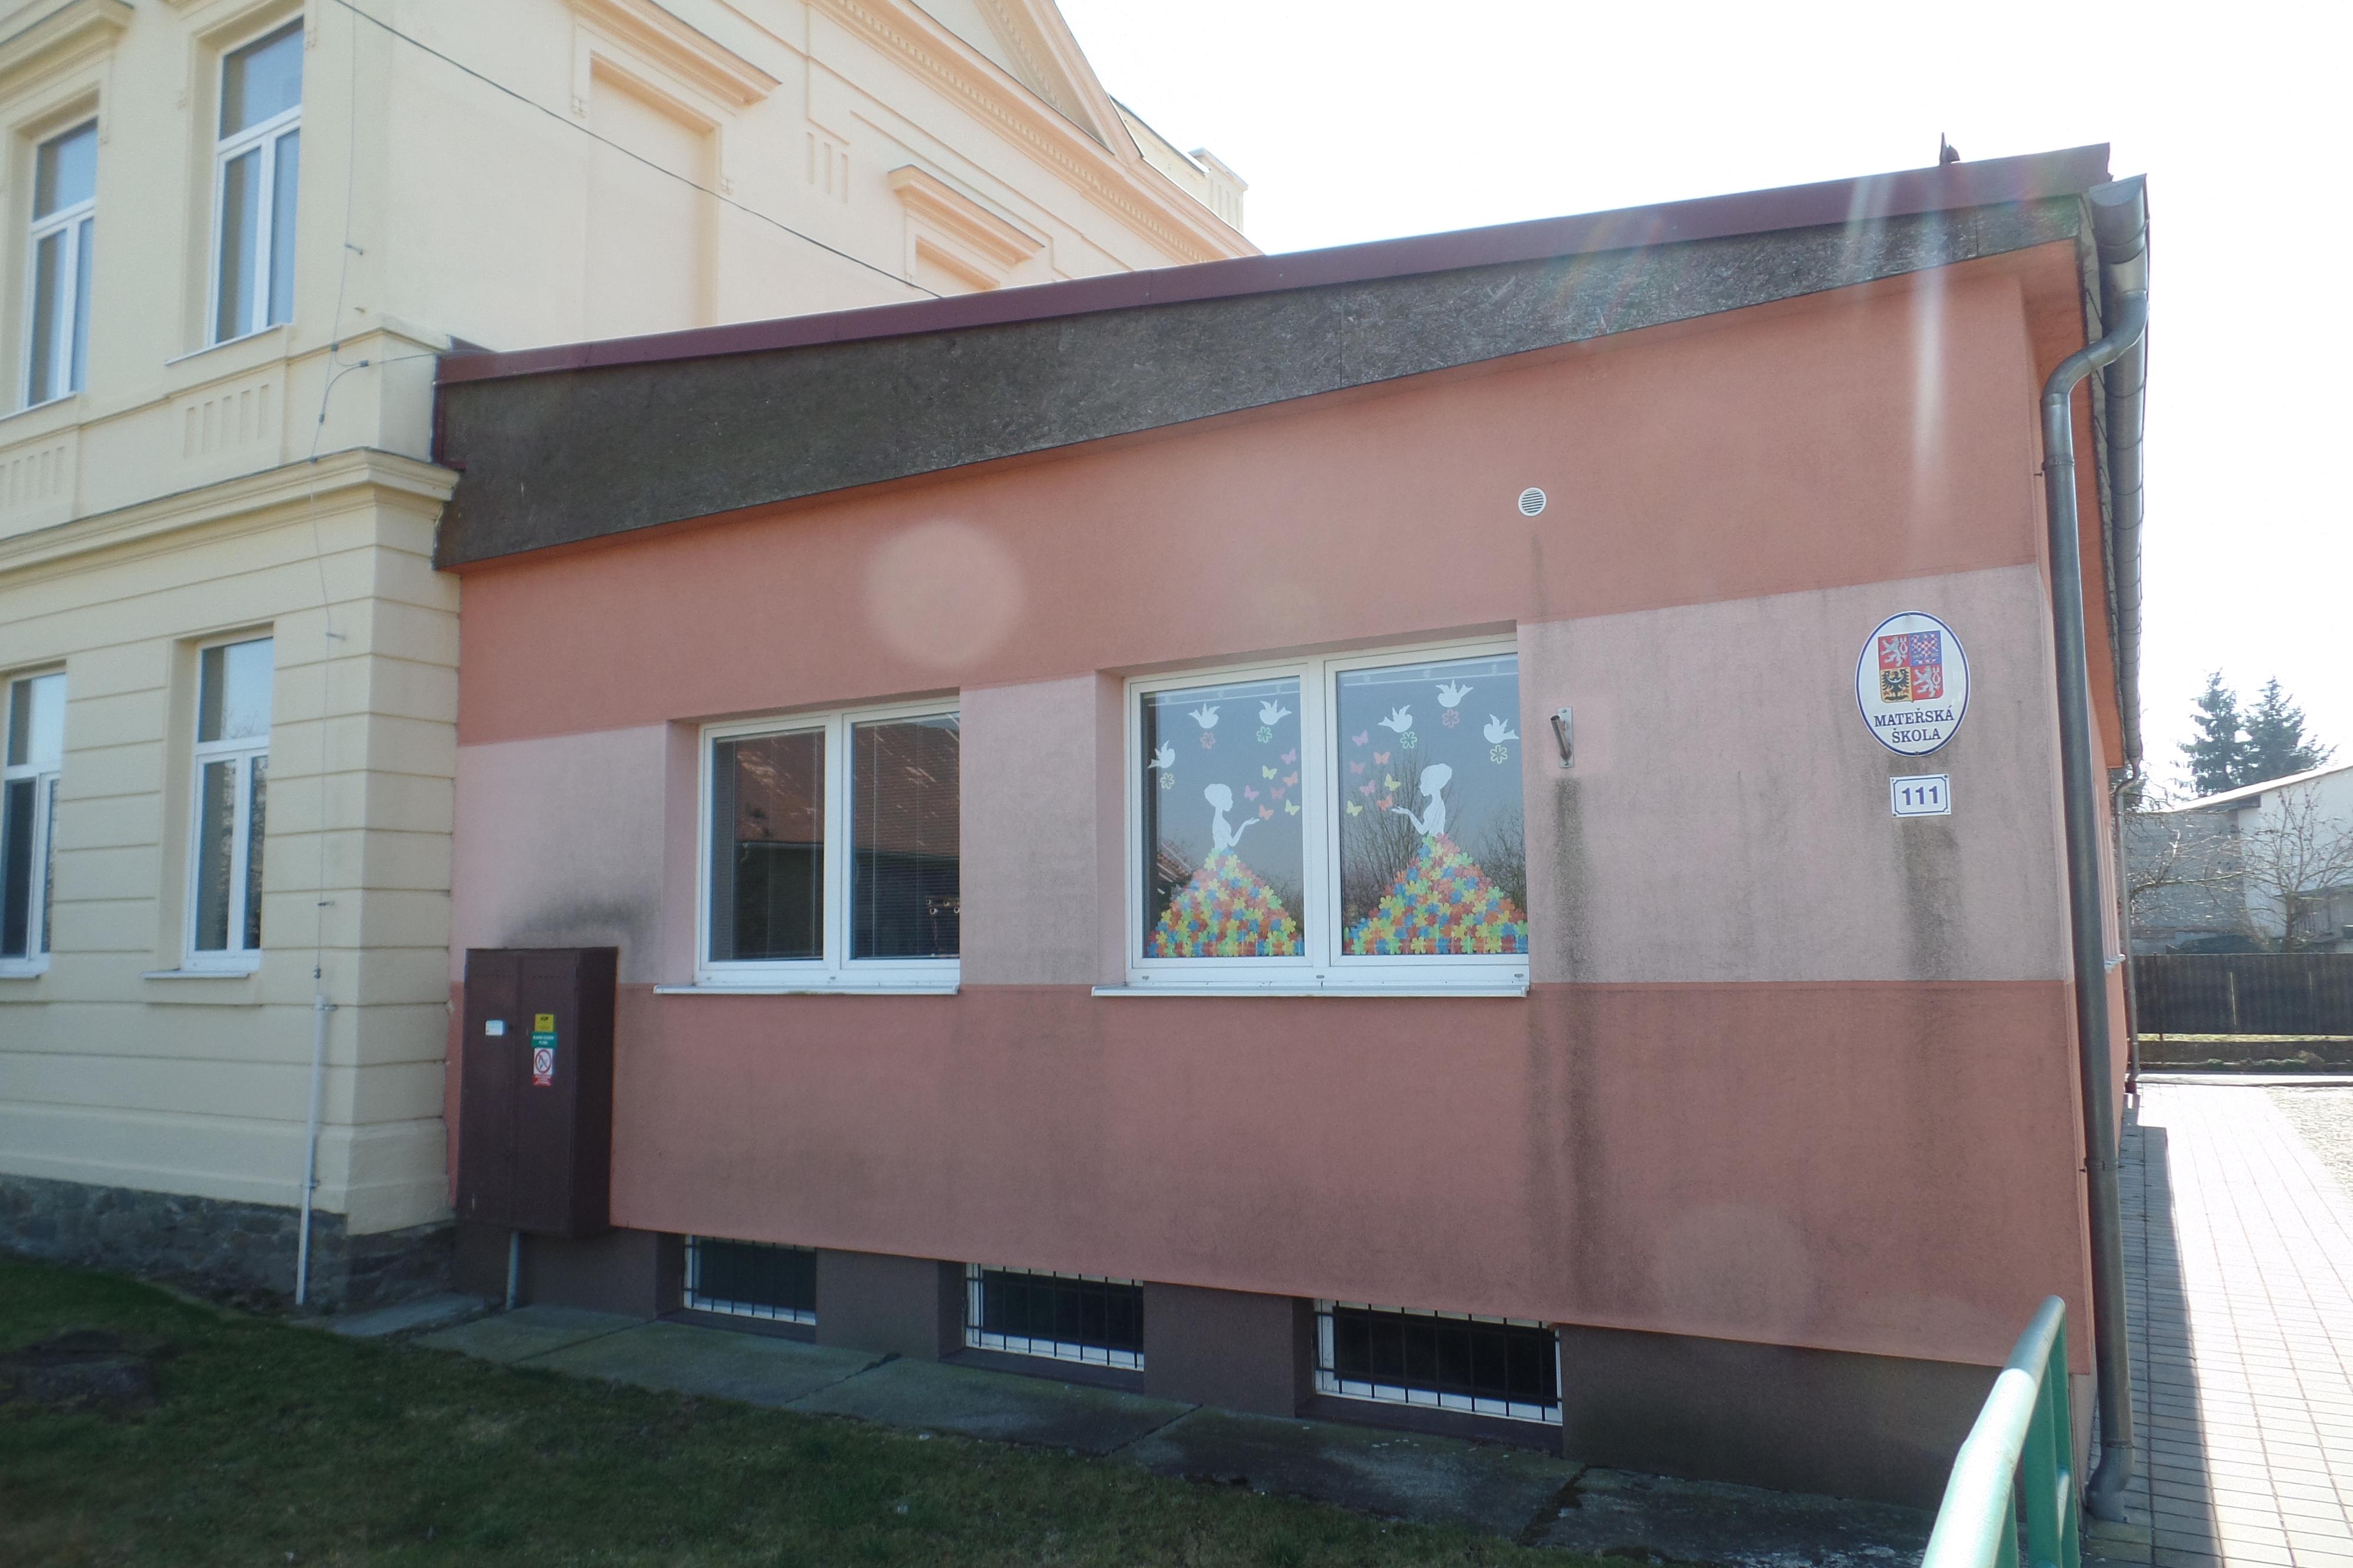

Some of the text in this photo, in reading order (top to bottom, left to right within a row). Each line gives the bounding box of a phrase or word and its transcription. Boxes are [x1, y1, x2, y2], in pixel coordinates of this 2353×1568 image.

[1874, 705, 1954, 727] MATEŘSKÁ
[1892, 727, 1941, 743] ŠKOLA
[1902, 786, 1938, 805] 111
